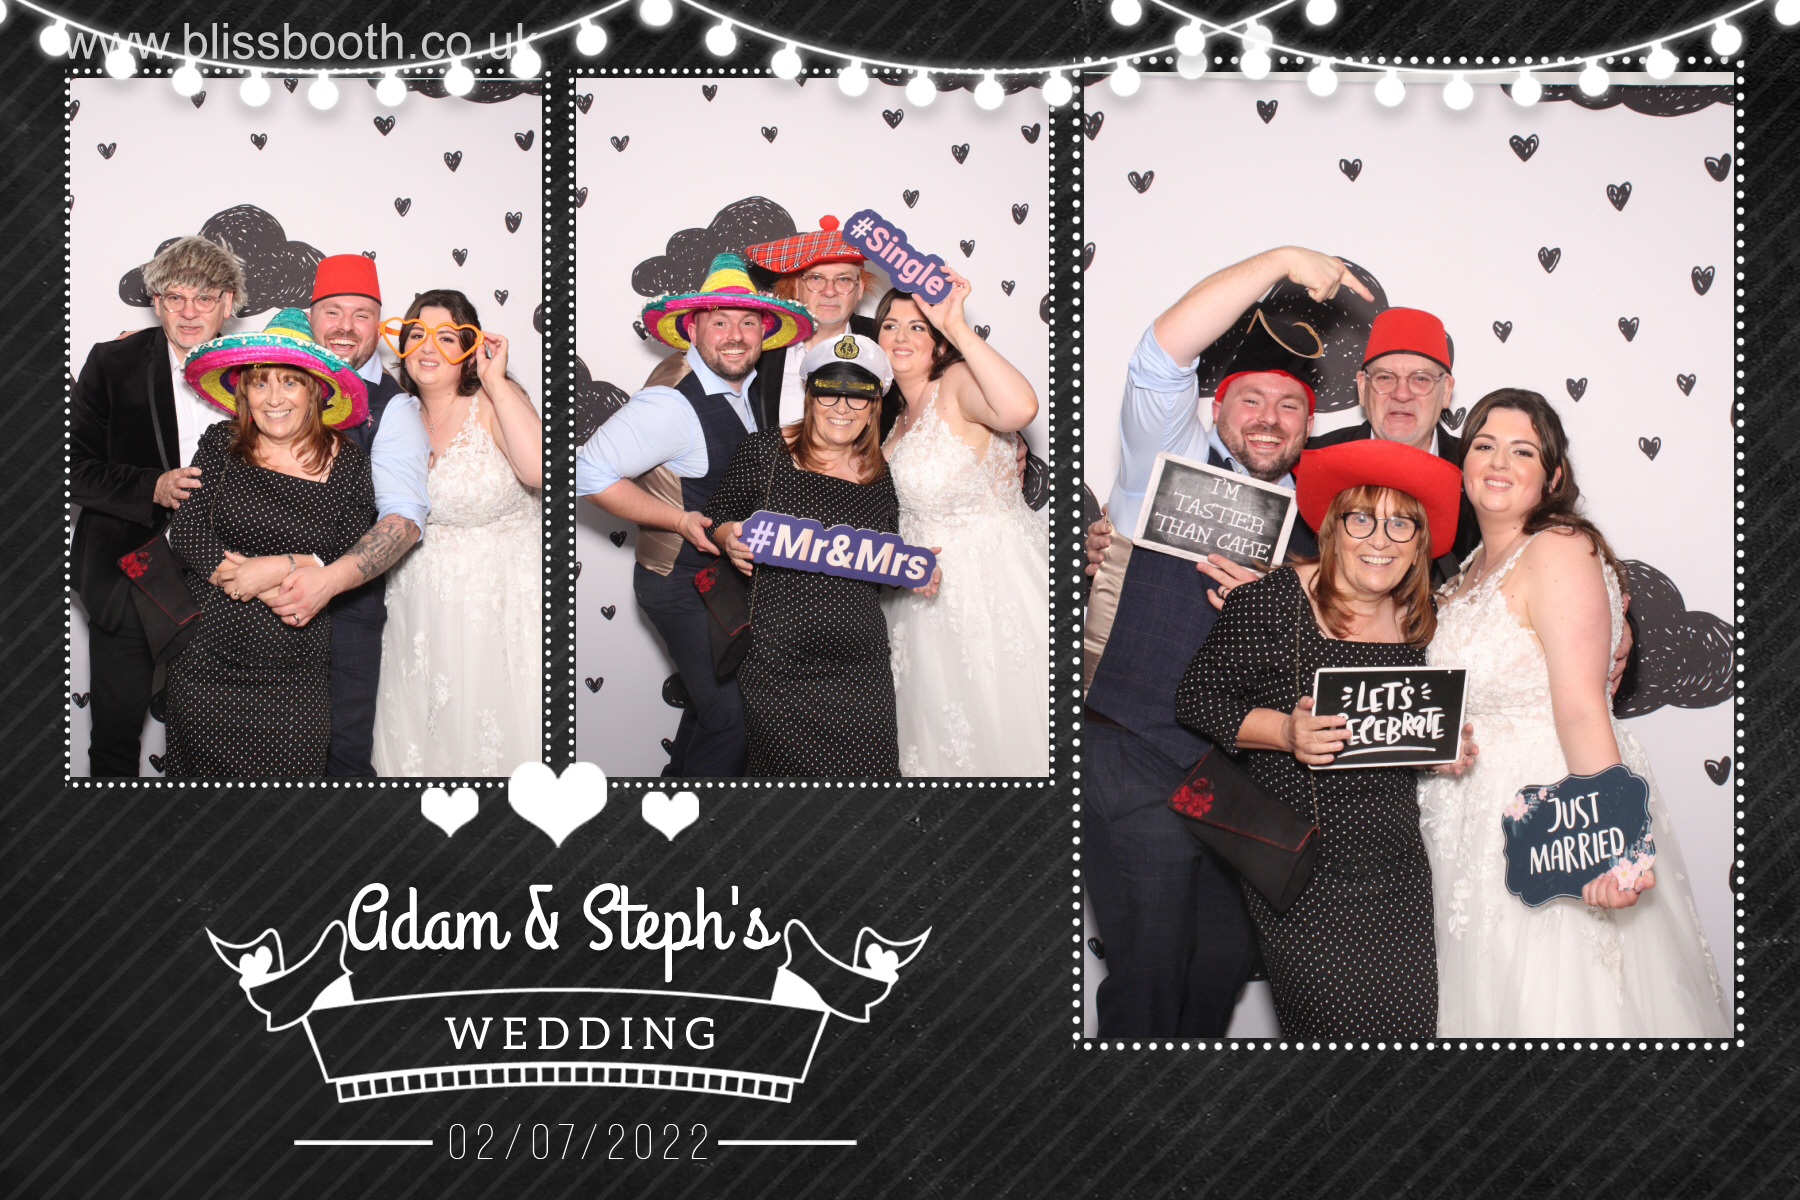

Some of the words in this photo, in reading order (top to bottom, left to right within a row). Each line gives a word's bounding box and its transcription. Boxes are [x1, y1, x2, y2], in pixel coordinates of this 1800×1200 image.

[851, 216, 945, 296] #Single
[1173, 491, 1265, 535] TASTIER
[1211, 477, 1242, 501] I'M
[747, 520, 928, 580] #Mr&Mrs
[1155, 512, 1214, 544] THAN
[1216, 533, 1271, 562] CAKE
[1547, 791, 1599, 833] JUST
[1530, 827, 1625, 875] MARRIED
